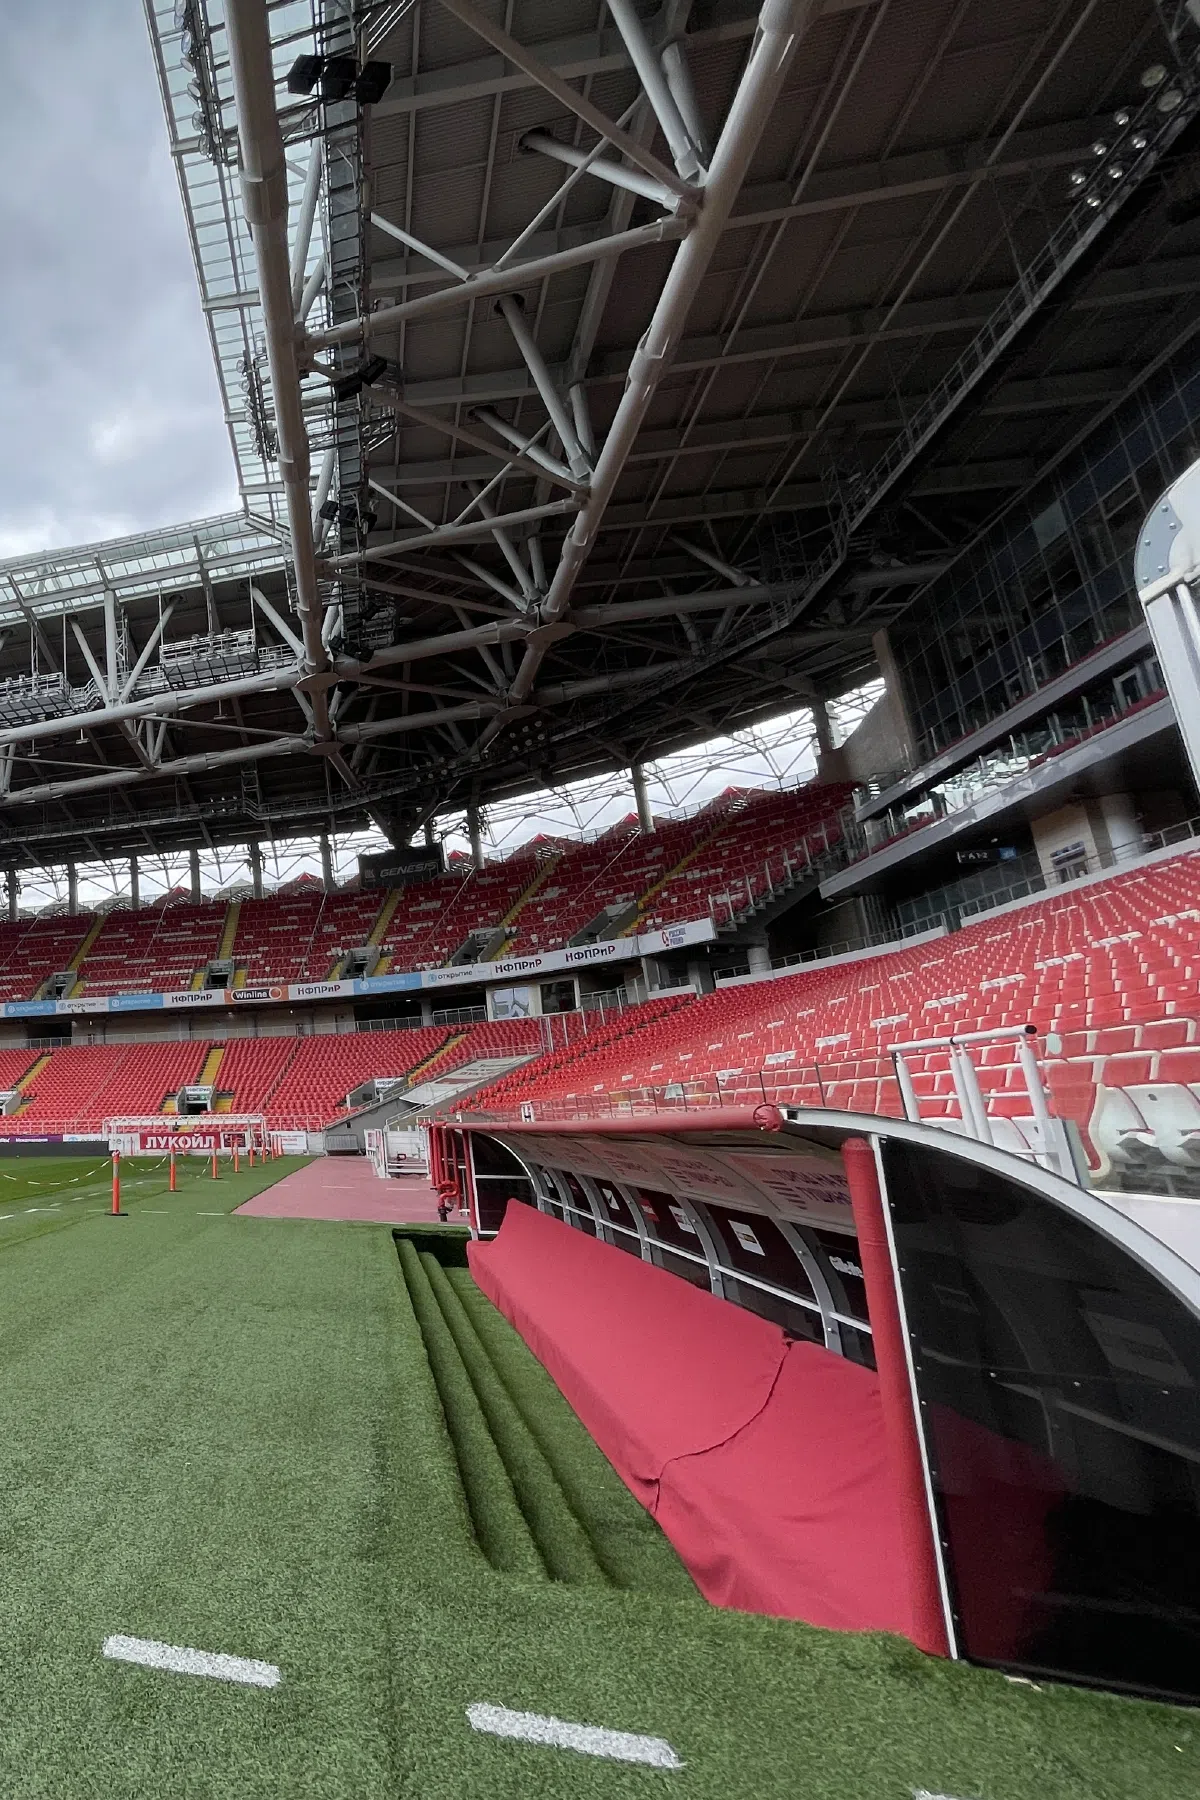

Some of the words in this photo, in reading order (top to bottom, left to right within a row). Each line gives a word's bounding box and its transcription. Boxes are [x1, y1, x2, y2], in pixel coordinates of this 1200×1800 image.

[380, 862, 437, 878] GENESIS
[437, 970, 473, 980] открытие
[235, 990, 268, 1000] Winline
[145, 1134, 216, 1149] ЛУКОЙЛ
